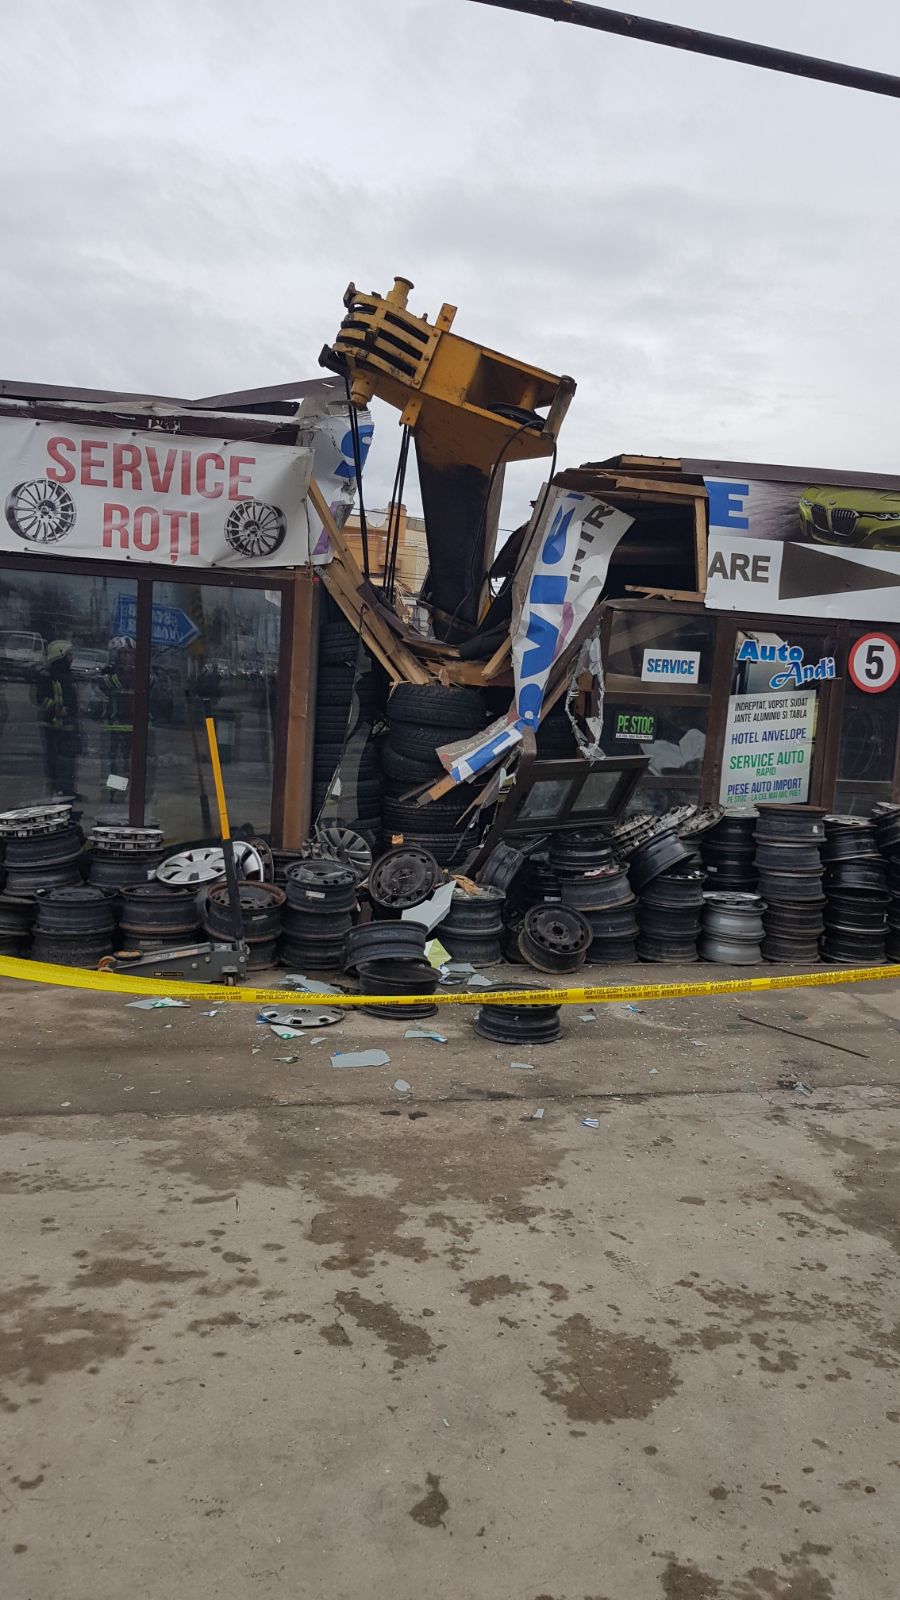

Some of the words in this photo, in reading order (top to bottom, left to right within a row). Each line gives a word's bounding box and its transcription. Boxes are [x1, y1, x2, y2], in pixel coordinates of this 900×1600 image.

[46, 437, 257, 501] SERVICE
[707, 551, 771, 584] ARE
[736, 639, 805, 664] Auto
[646, 657, 696, 676] SERVICE
[864, 644, 885, 680] 5
[769, 656, 836, 690] Andi
[790, 697, 809, 708] SUDAT
[617, 714, 630, 733] PE
[630, 715, 654, 734] STOC
[733, 713, 752, 724] JANTE
[752, 711, 780, 722] ALUMINIU
[782, 710, 788, 720] SI
[789, 709, 807, 719] TABLA
[731, 731, 759, 745] HOTEL
[761, 727, 807, 742] ANVELOPE
[729, 752, 775, 770] SERVICE
[776, 749, 805, 765] AUTO
[755, 767, 776, 777] RAPID
[727, 783, 750, 796] PIESE
[751, 781, 772, 794] AUTO
[773, 777, 802, 791] IMPORT
